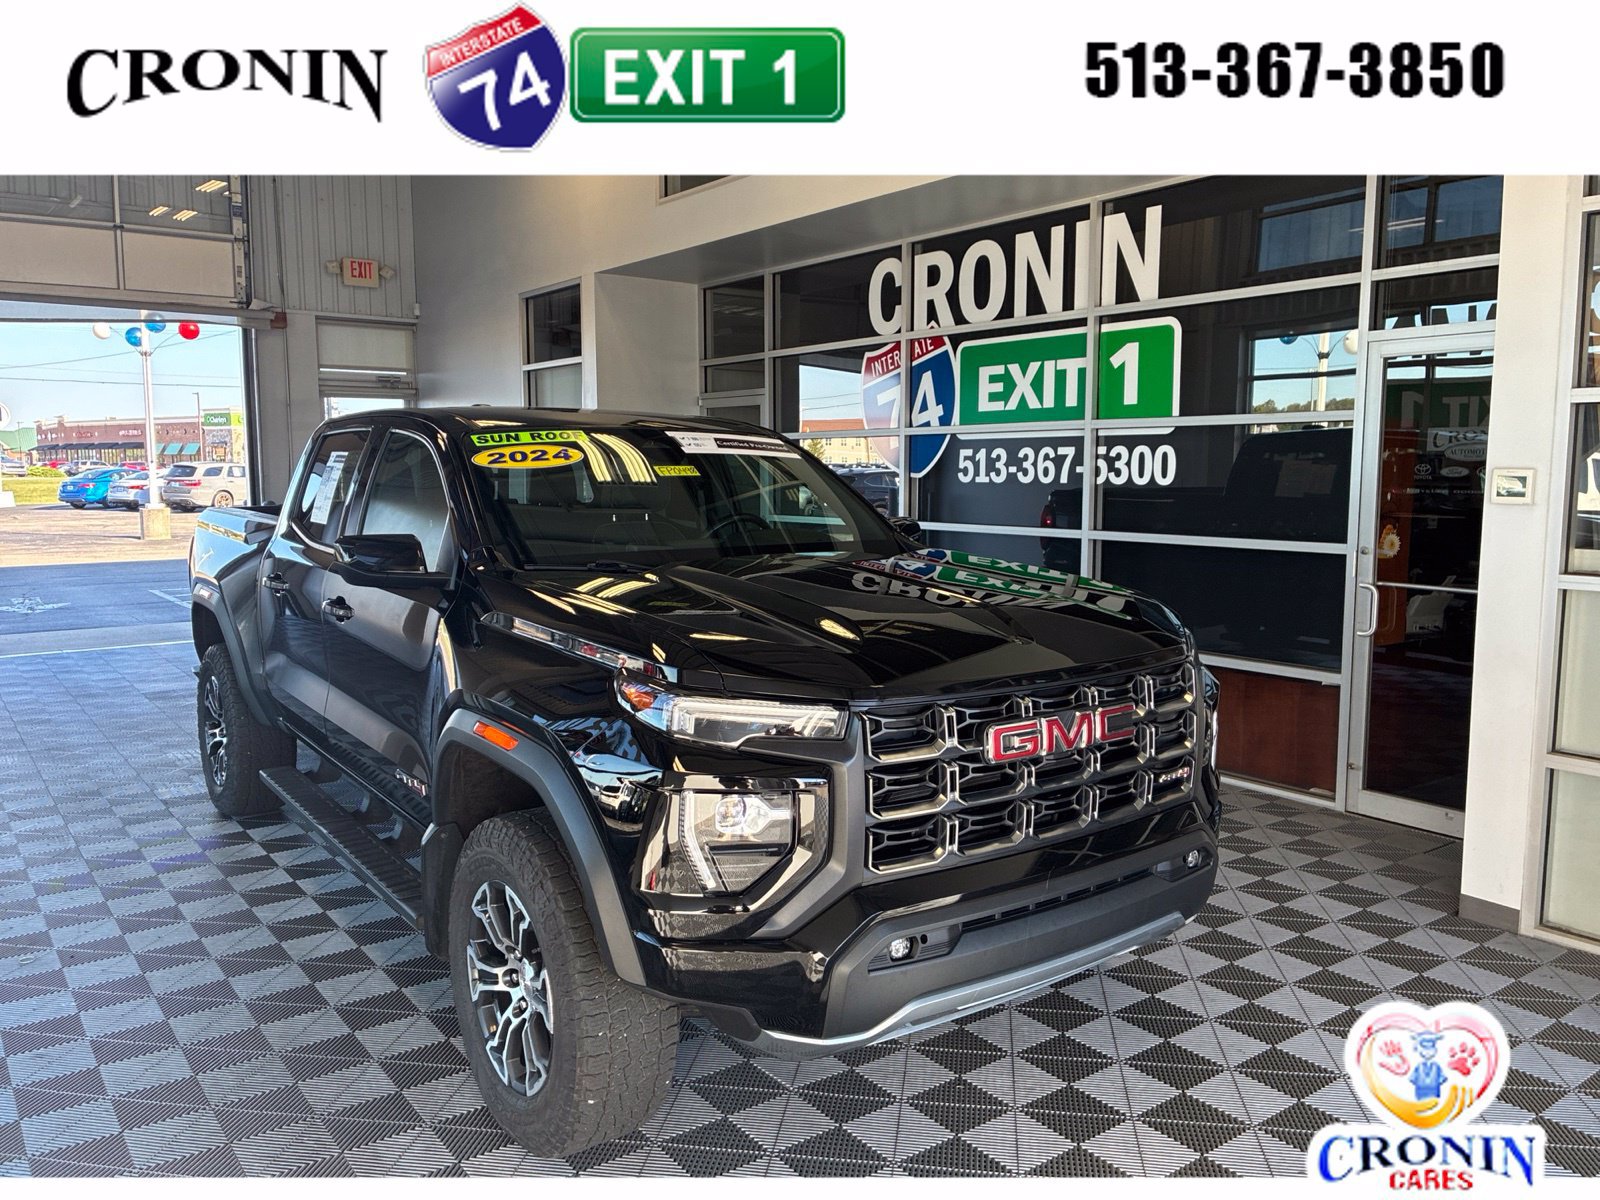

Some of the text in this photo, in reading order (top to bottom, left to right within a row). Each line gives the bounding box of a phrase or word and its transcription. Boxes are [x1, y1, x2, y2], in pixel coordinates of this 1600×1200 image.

[350, 260, 373, 280] EXIT
[868, 204, 1162, 336] CRONIN
[977, 342, 1140, 412] EXIT 1
[476, 431, 582, 444] SUN ROOF
[487, 448, 573, 464] 2024
[957, 445, 1177, 486] 513-367-5300
[986, 702, 1136, 764] GMC
